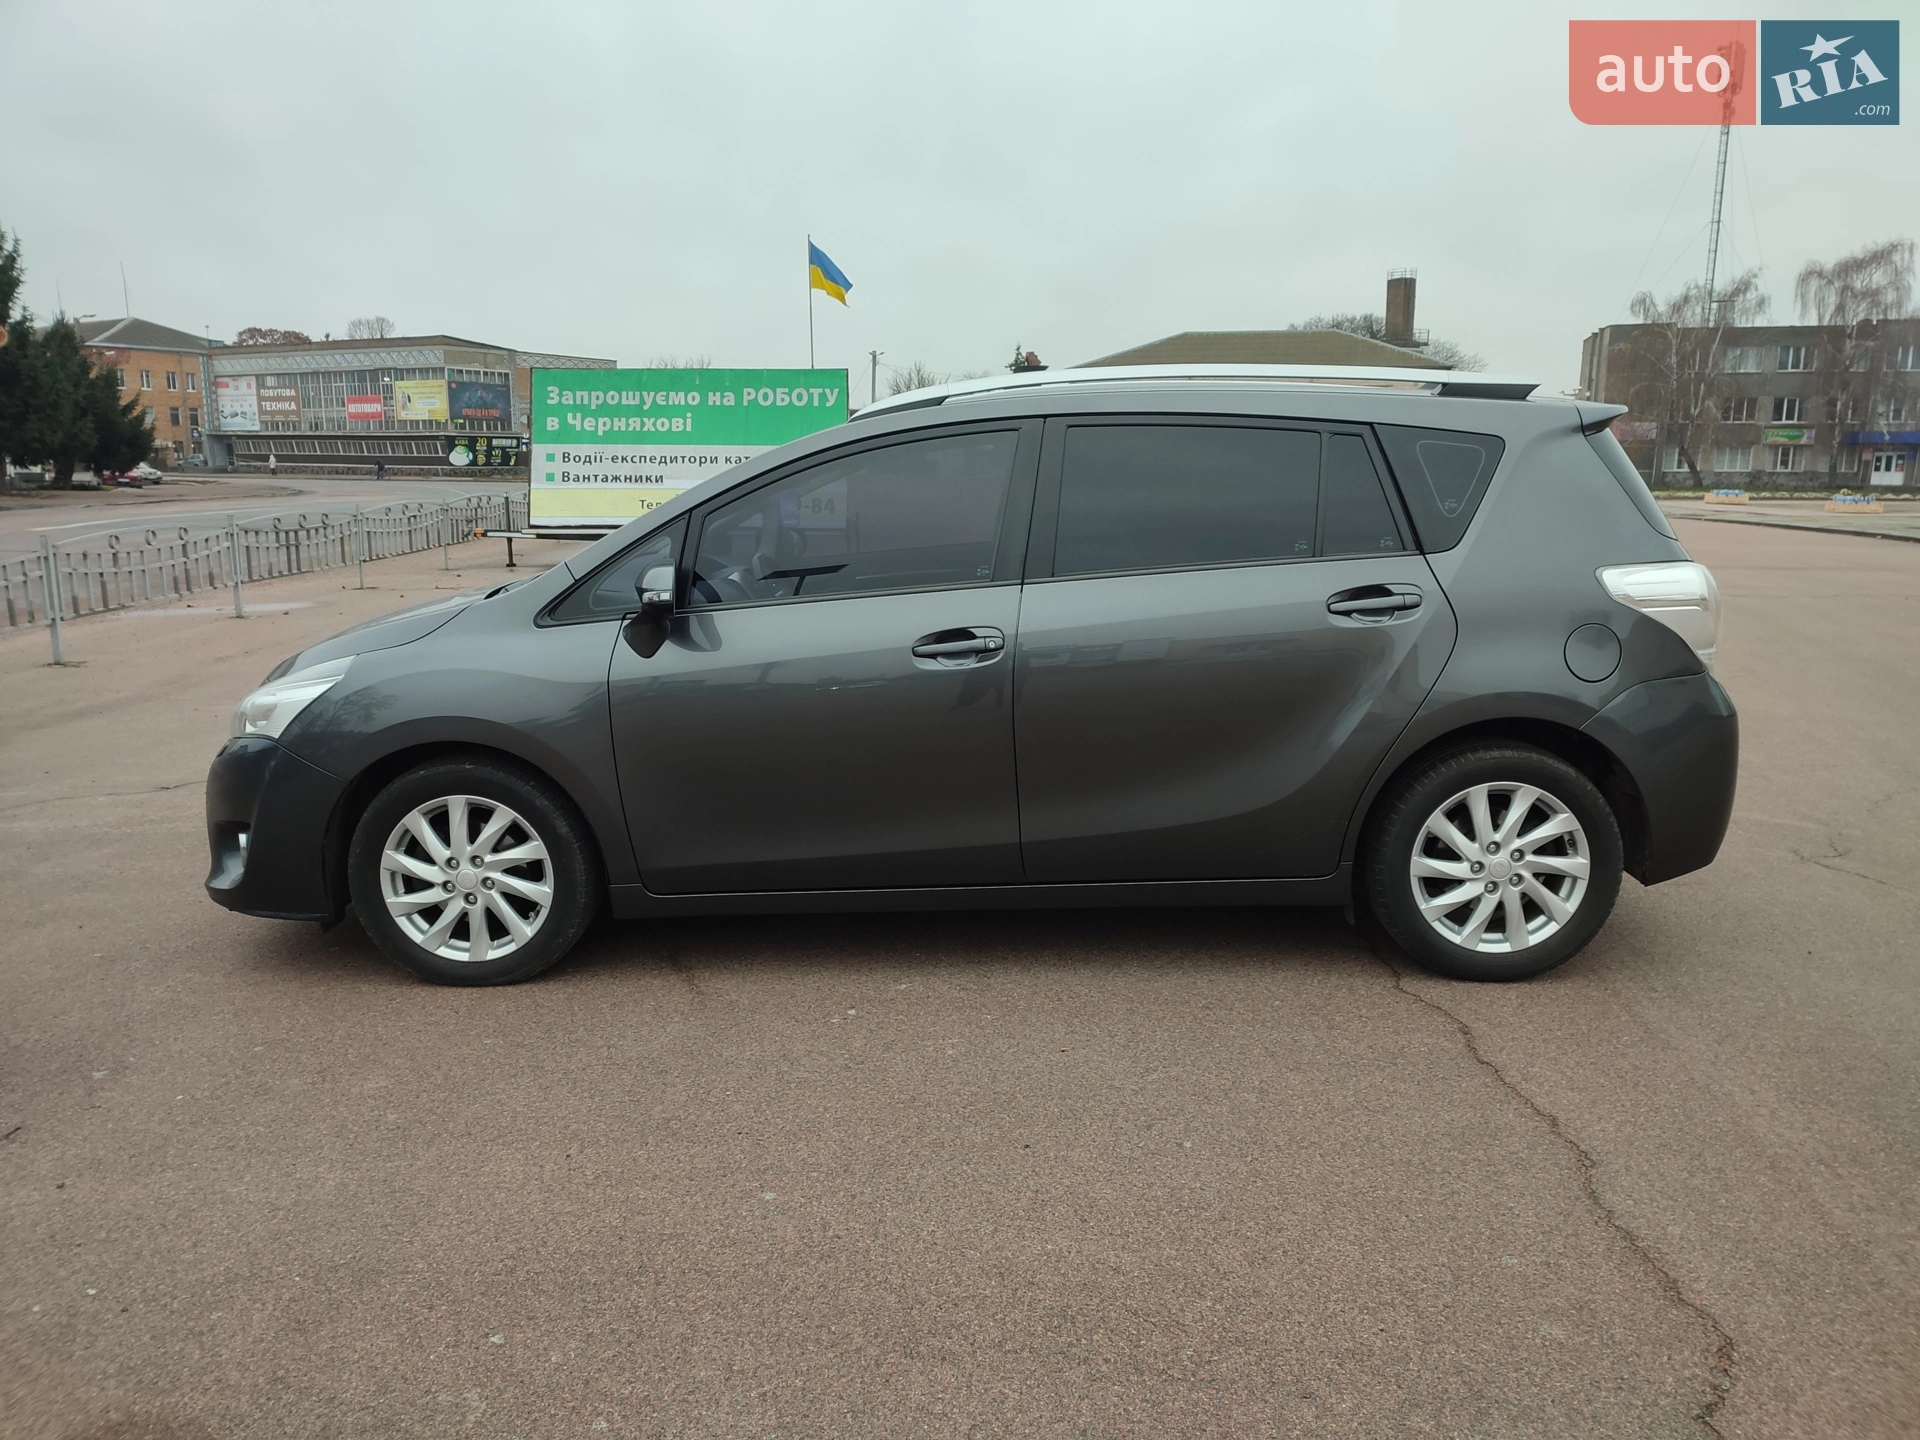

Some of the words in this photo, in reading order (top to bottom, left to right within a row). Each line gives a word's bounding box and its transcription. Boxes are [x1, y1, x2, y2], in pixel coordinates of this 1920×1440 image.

[260, 388, 296, 397] ПОБУТОВА
[546, 386, 700, 410] Запрошуємо
[708, 387, 735, 405] на
[743, 388, 839, 406] РОБОТУ
[261, 401, 297, 411] ТЕХНІКА
[546, 416, 559, 431] в
[567, 413, 692, 435] Черняхові
[476, 437, 487, 446] 20
[562, 451, 719, 467] Водії-експедитори
[562, 471, 664, 484] Вантажники
